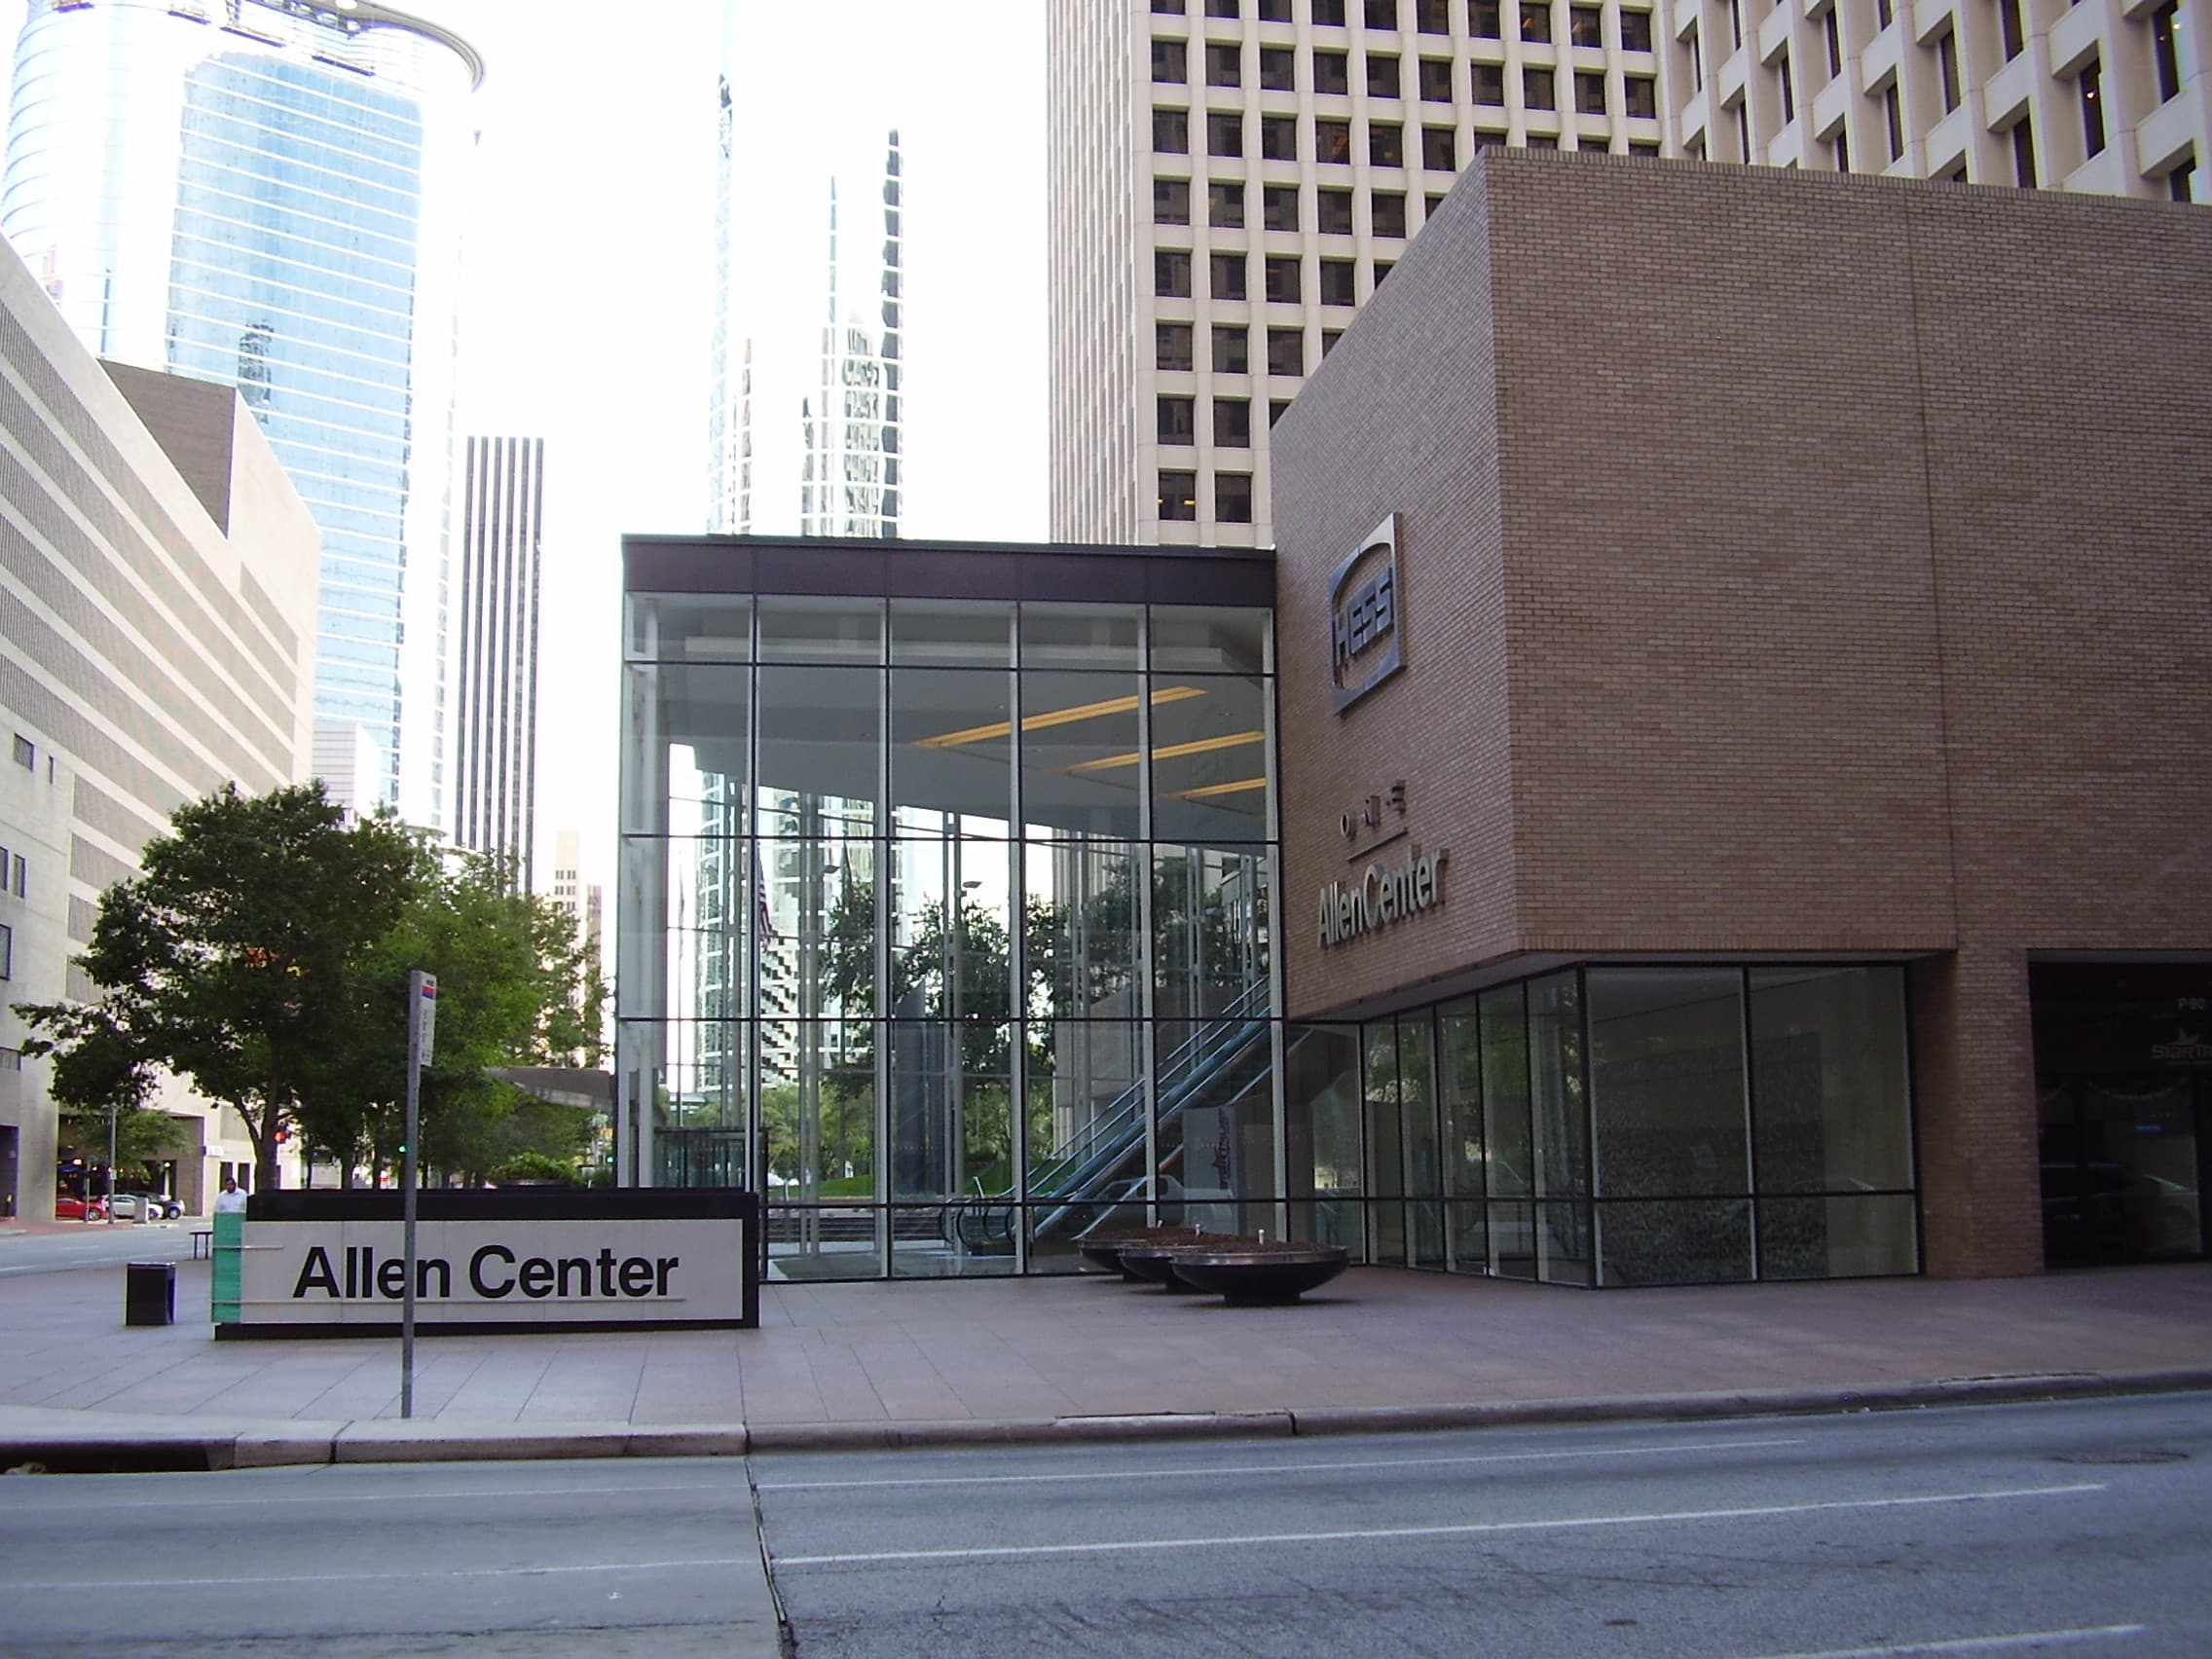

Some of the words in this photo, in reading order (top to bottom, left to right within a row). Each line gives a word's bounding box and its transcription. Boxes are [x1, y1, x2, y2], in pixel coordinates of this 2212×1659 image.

[1334, 567, 1393, 667] HESS
[1340, 780, 1406, 839] ONE
[292, 1245, 451, 1300] Allen
[468, 1244, 679, 1299] Center
